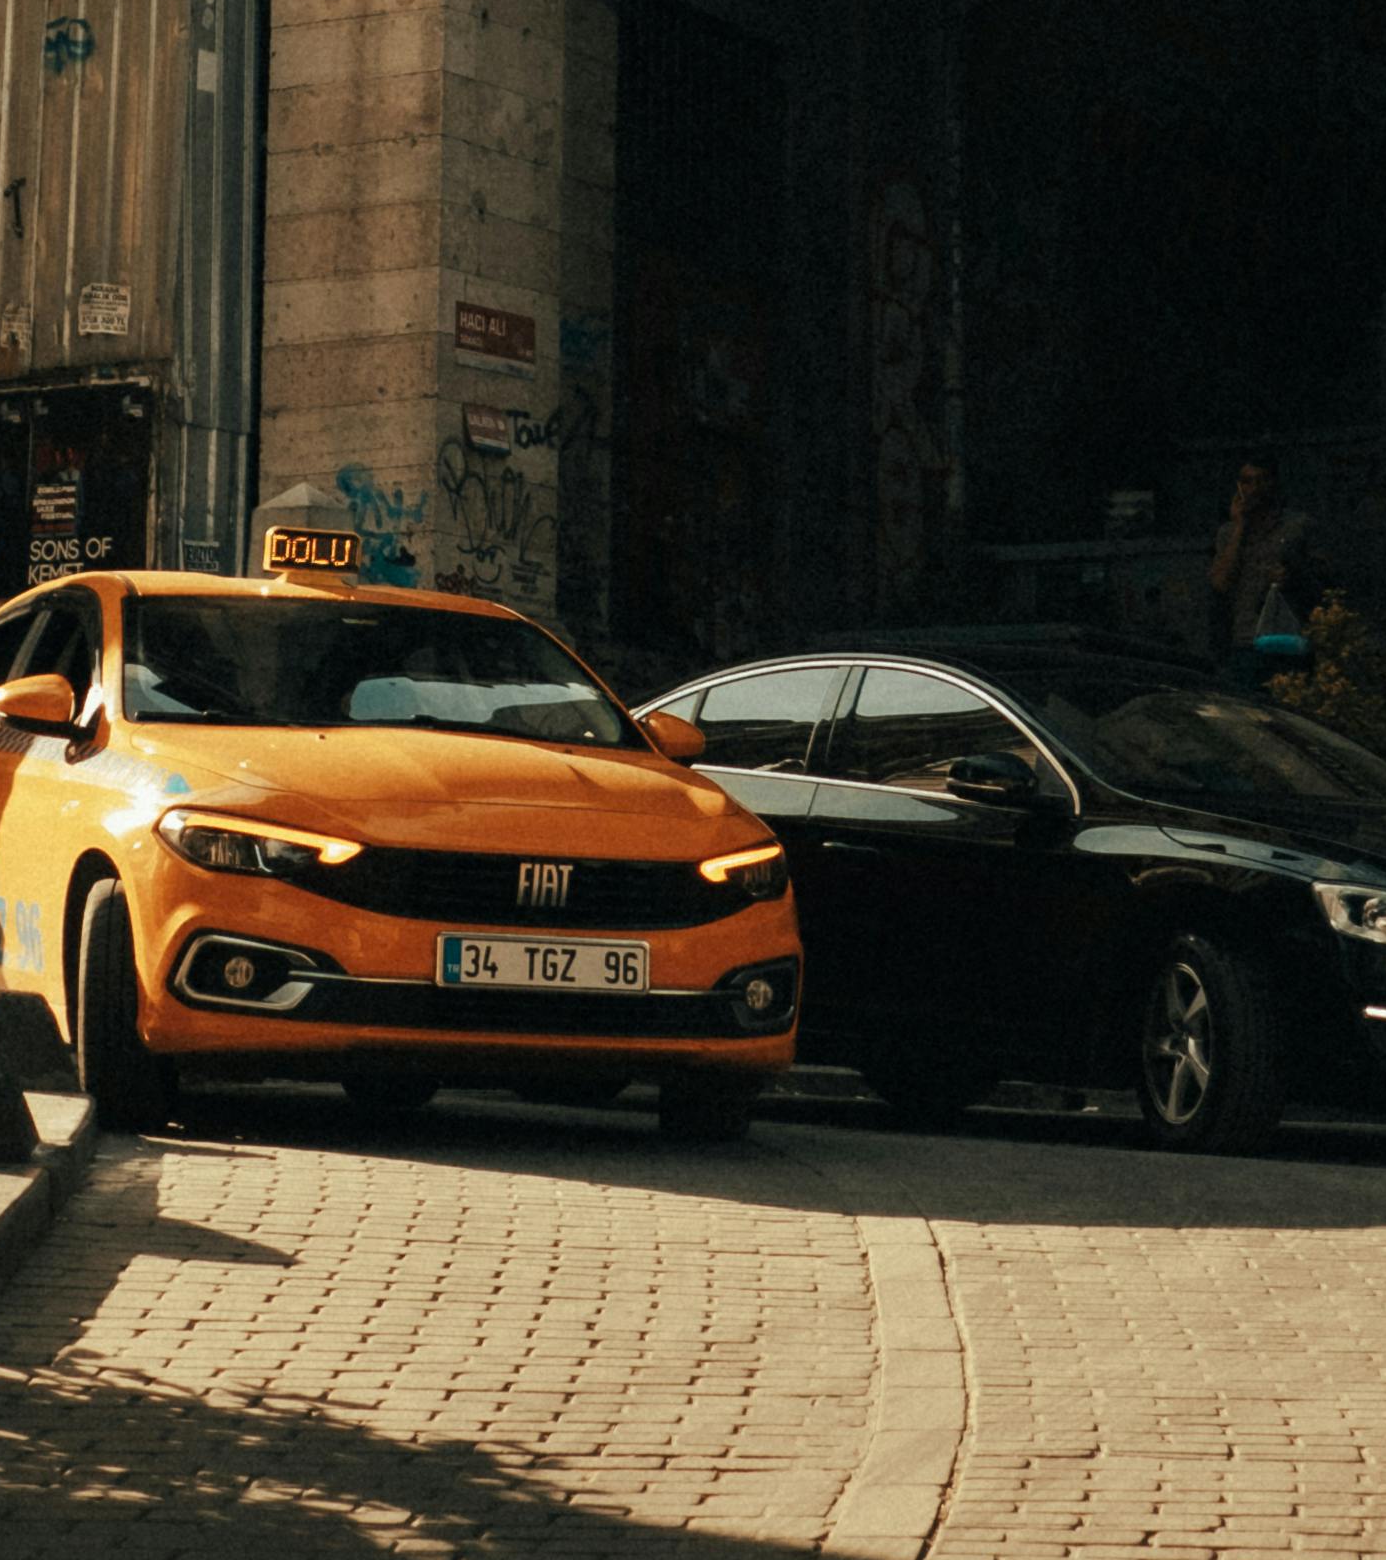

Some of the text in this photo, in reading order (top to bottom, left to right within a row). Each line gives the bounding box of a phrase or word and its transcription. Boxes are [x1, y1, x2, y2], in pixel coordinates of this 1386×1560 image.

[460, 311, 486, 334] HACI
[29, 536, 114, 561] SONS OF
[271, 533, 351, 568] DOLU
[516, 861, 575, 908] FIAT
[464, 944, 498, 979] 34
[524, 947, 577, 982] TGZ
[604, 951, 638, 985] 96
